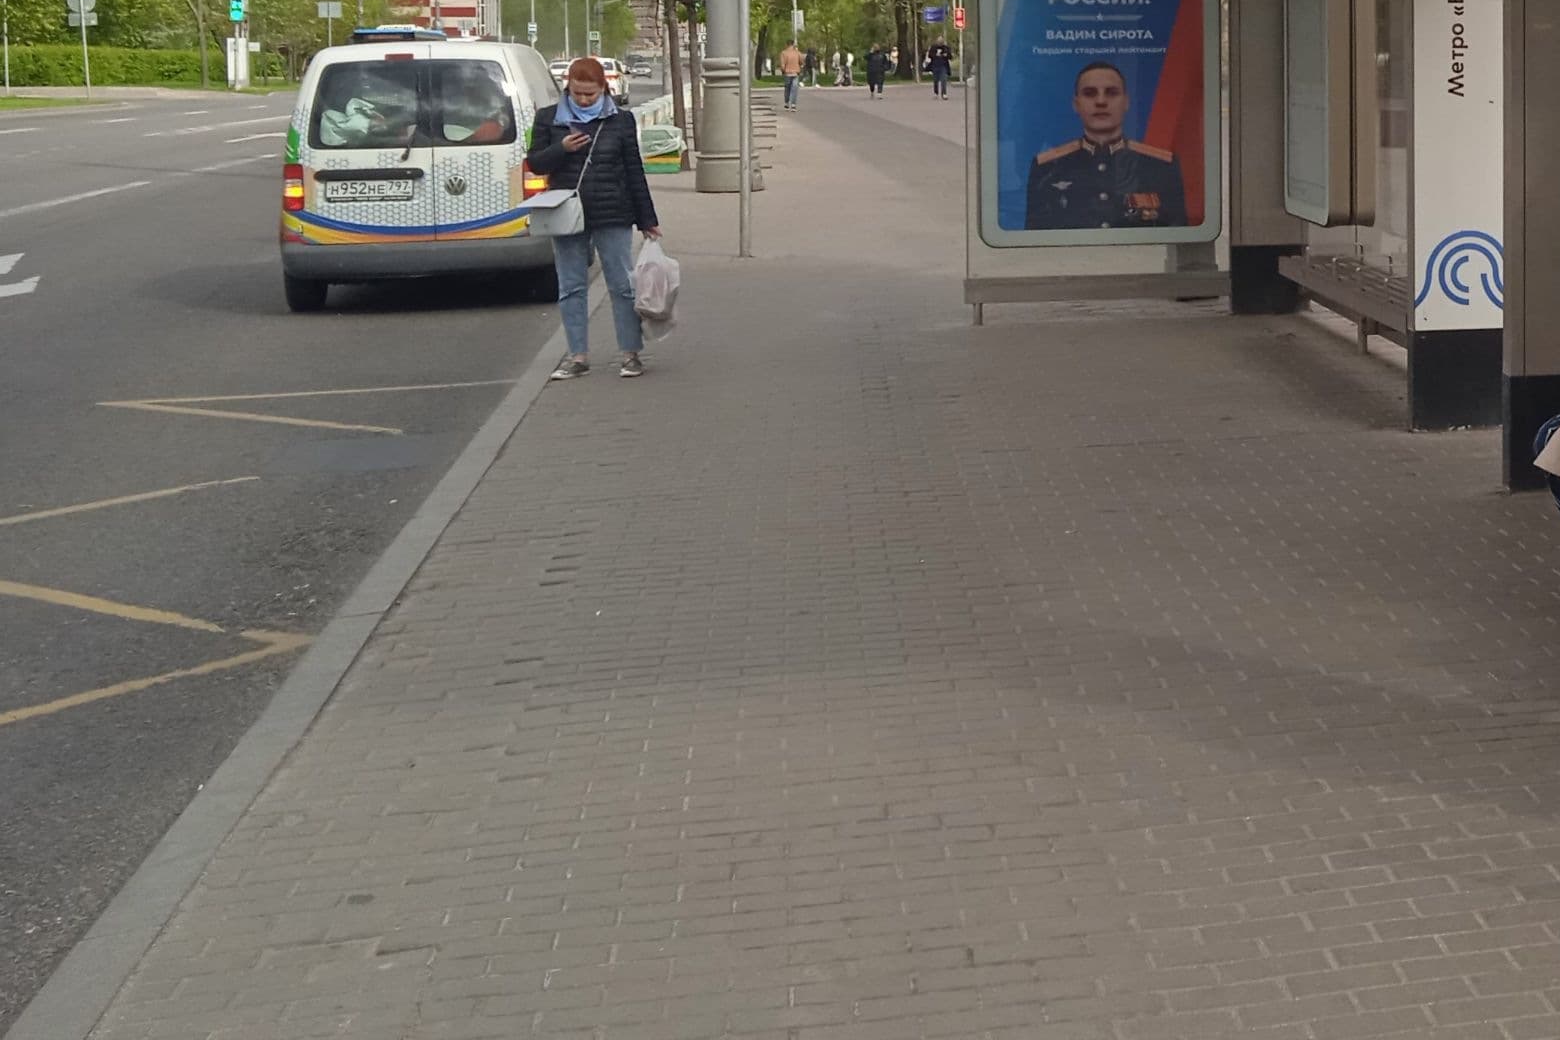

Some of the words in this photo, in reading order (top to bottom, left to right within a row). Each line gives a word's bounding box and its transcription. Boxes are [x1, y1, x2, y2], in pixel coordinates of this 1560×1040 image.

[1046, 29, 1096, 41] ВАДИМ
[1099, 29, 1153, 40] СИРОТА
[1447, 22, 1468, 98] Метро
